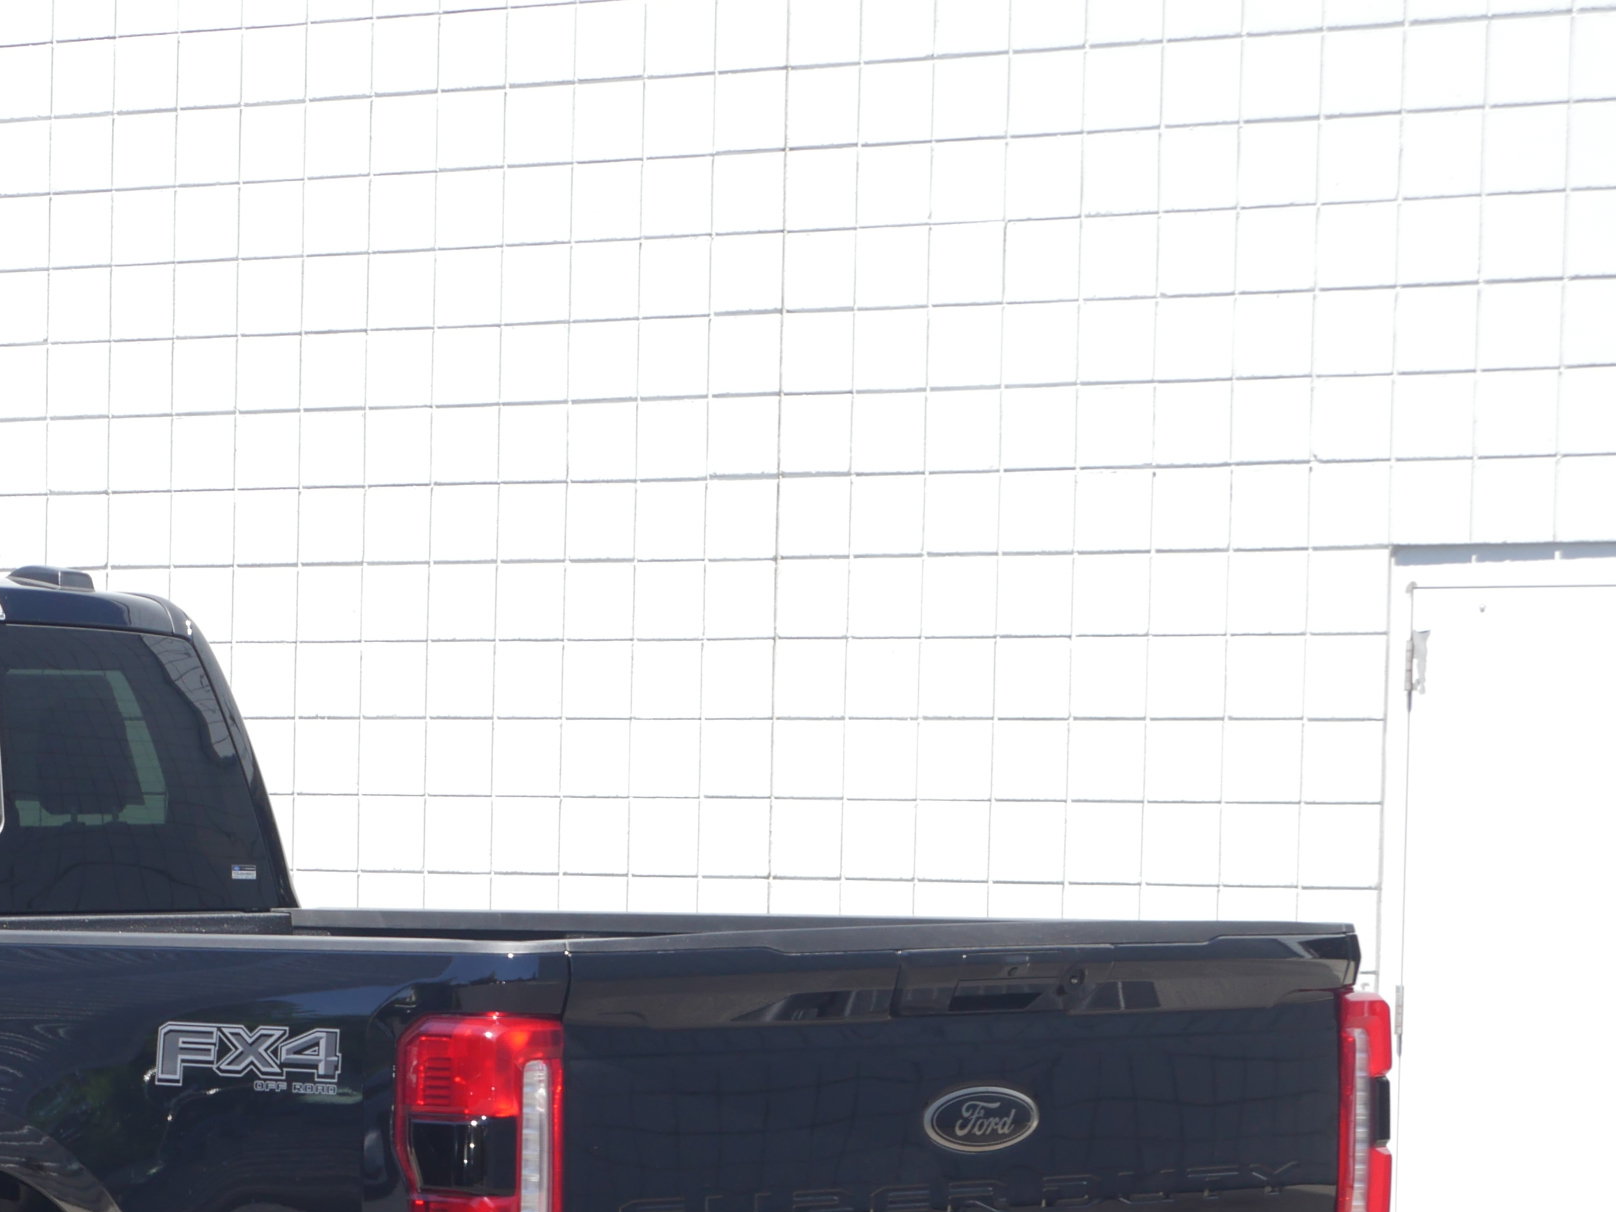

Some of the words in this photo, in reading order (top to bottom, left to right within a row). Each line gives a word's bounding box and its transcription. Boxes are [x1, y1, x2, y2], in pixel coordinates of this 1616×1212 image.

[155, 1021, 341, 1086] FX4
[254, 1081, 287, 1092] OFF
[292, 1082, 337, 1095] ROAD
[955, 1101, 1016, 1137] Ford
